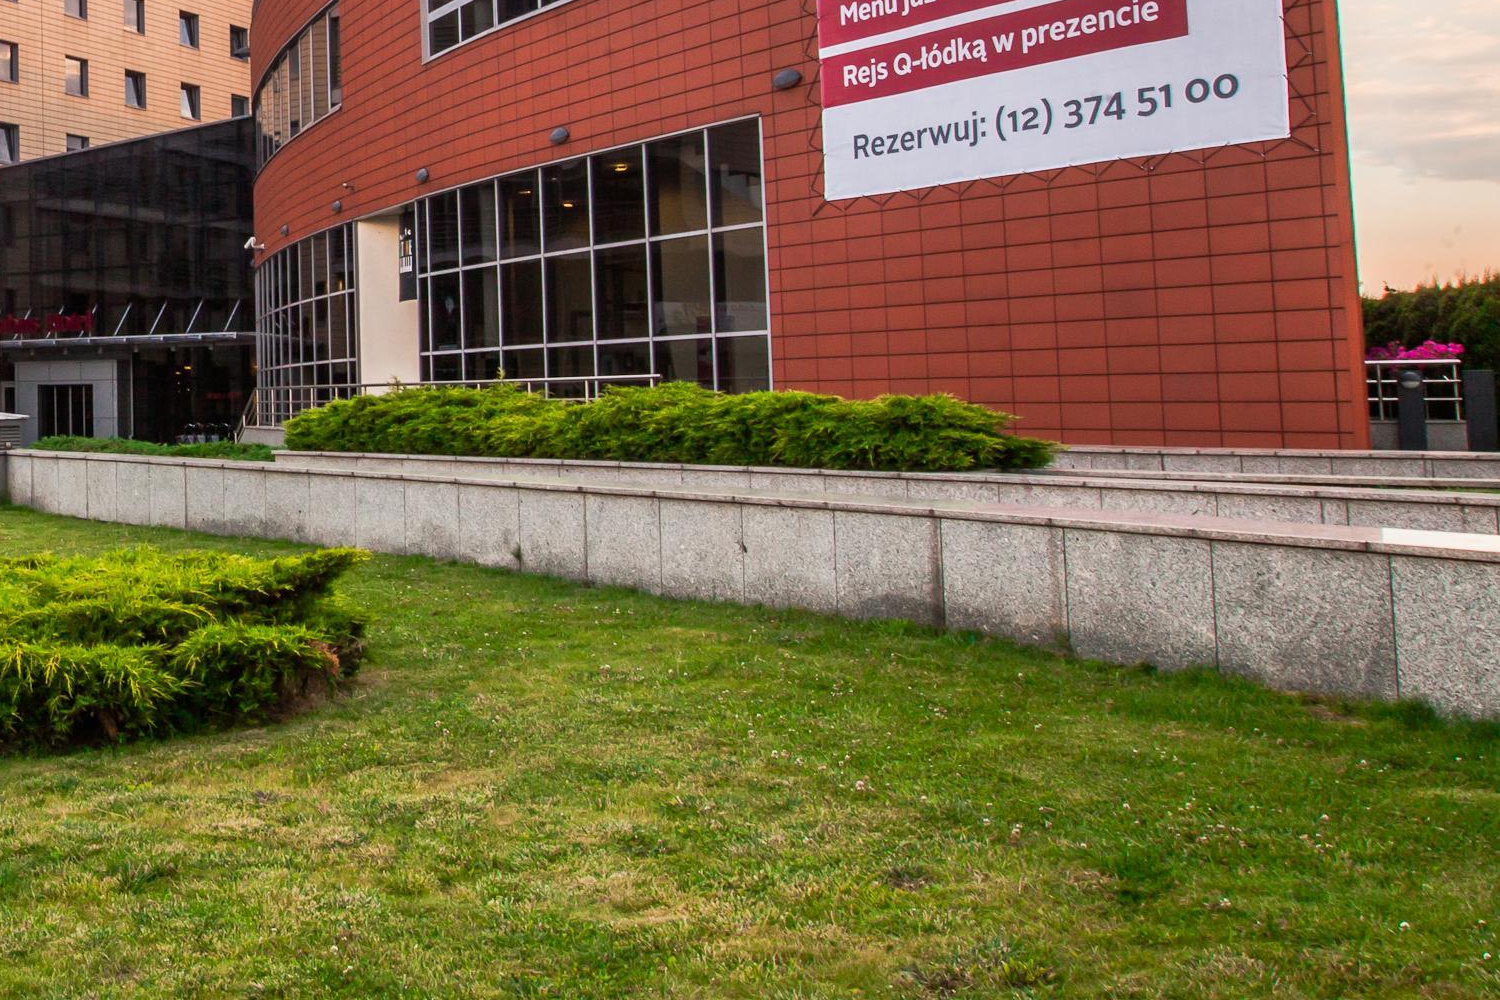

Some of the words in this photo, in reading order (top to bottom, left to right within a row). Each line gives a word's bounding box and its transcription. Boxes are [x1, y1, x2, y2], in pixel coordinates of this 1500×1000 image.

[843, 59, 888, 88] Rejs
[893, 38, 988, 78] Q-łódką
[992, 31, 1015, 54] w
[852, 111, 988, 160] Rezerwuj:
[996, 97, 1054, 142] (12)
[1063, 91, 1126, 129] 374
[1137, 83, 1172, 117] 51
[1185, 73, 1239, 103] 00
